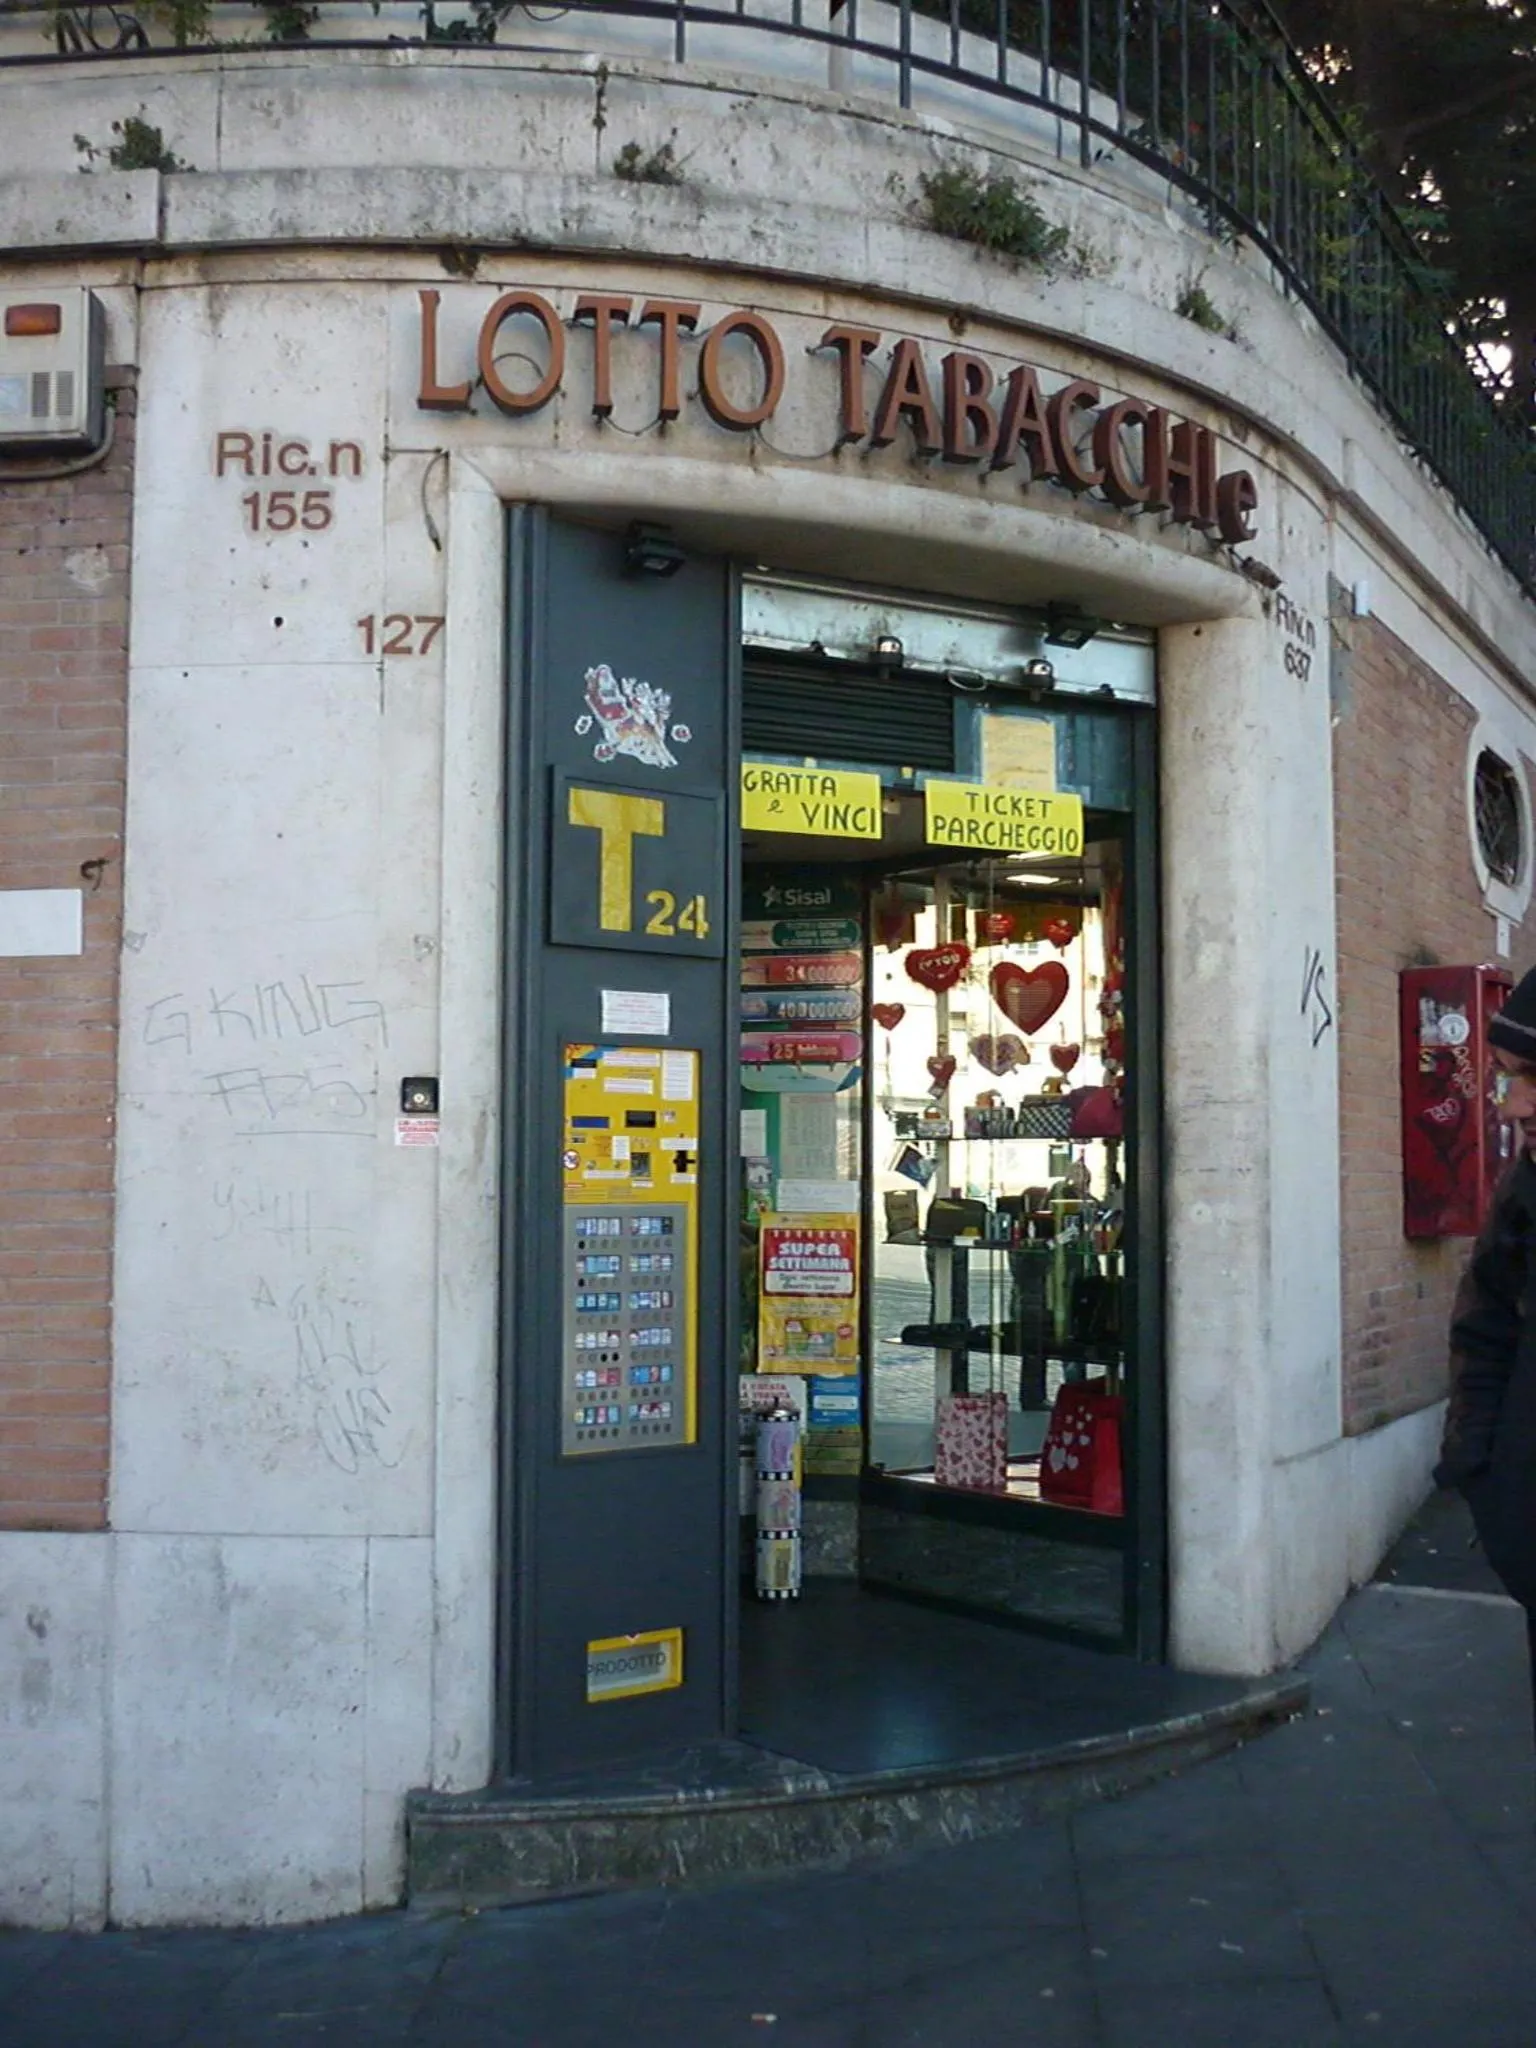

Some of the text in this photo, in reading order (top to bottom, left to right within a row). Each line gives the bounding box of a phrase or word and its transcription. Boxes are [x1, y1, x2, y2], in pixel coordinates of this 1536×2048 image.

[417, 289, 786, 432] LOTTO
[822, 326, 1219, 530] TABACCHI
[243, 491, 333, 532] 155
[357, 614, 446, 655] 127
[743, 769, 837, 797] GRATTA
[801, 802, 877, 834] VINCI
[965, 792, 1053, 819] TICKET
[932, 814, 1079, 854] PARCHEGGIO
[569, 787, 709, 939] T 24
[784, 887, 832, 906] Sisal
[778, 1243, 841, 1256] SUPER
